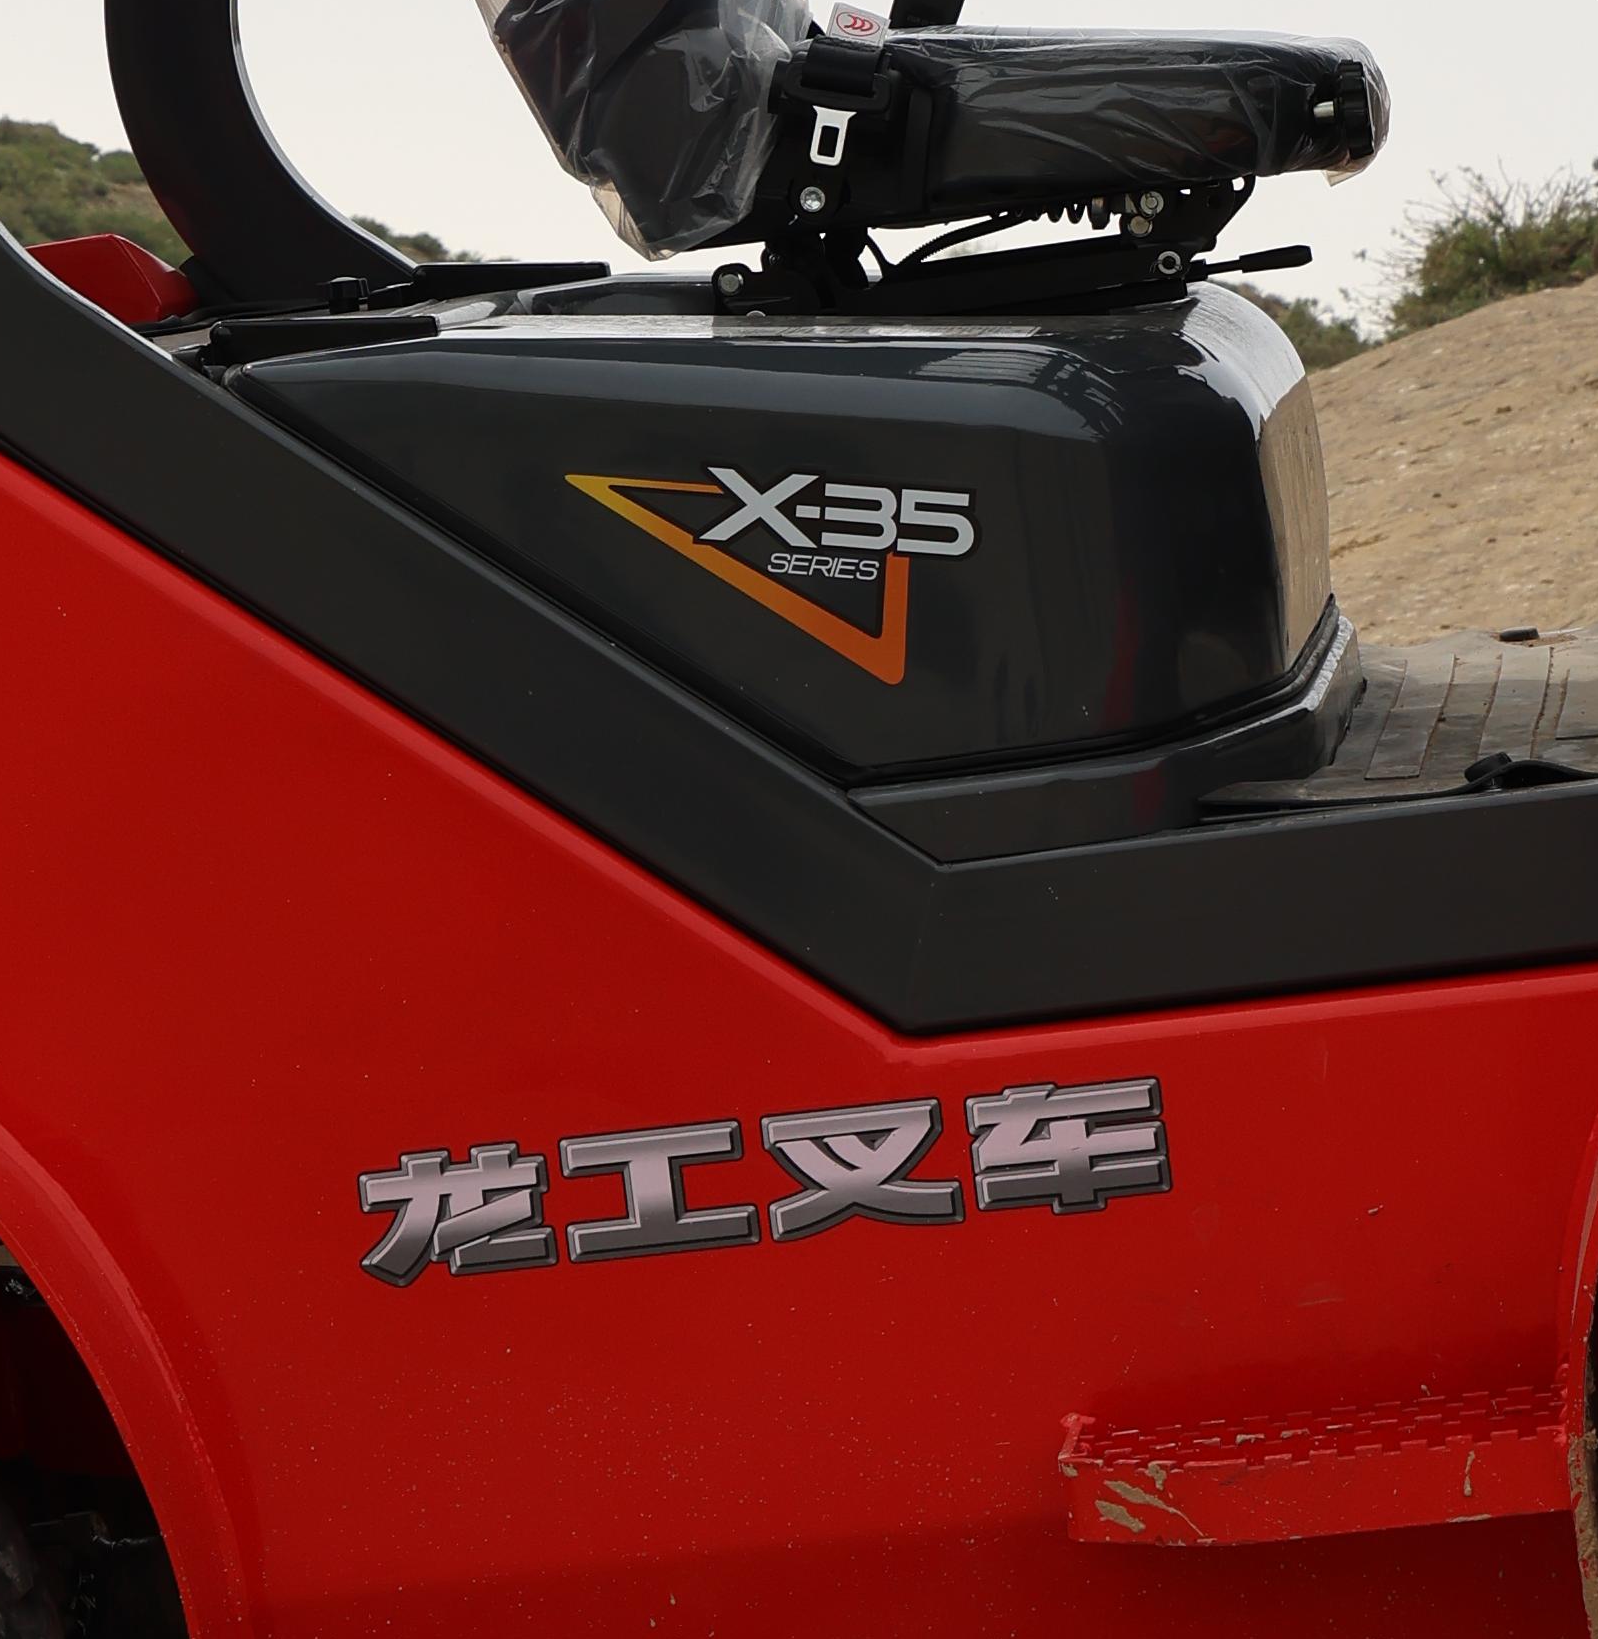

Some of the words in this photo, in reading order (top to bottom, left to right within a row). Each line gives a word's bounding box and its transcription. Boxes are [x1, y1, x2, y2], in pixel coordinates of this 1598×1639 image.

[698, 466, 975, 556] X-35
[767, 553, 880, 581] SERIES
[360, 1077, 1173, 1288] 龙工叉车
